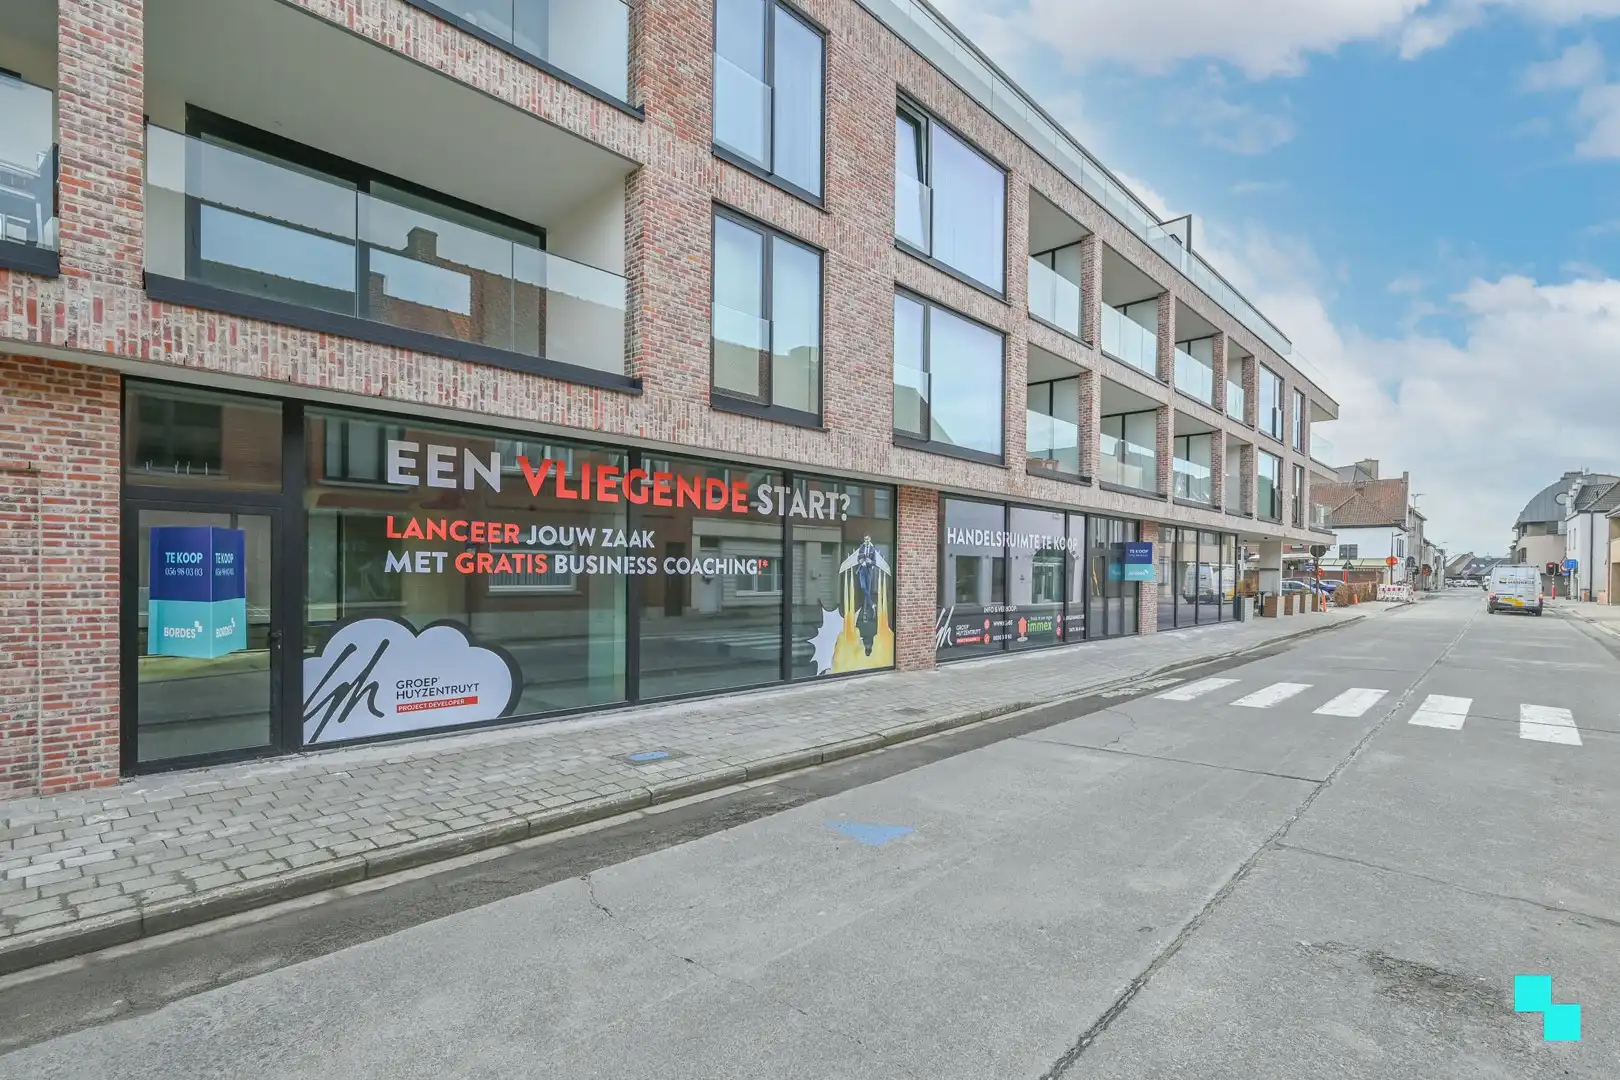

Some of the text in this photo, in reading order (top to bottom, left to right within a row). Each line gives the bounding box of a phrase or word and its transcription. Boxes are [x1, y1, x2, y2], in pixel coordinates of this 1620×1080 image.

[387, 440, 851, 521] EEN VLIEGENDE START?
[386, 516, 656, 549] LANCEER JOUW ZAAK
[947, 527, 1040, 550] HANDELSRUIMTE
[1041, 534, 1052, 550] TE
[165, 552, 203, 564] TE KOOP
[215, 553, 234, 564] TE KOOP
[384, 550, 448, 573] MET
[454, 552, 548, 574] GRATIS
[554, 554, 658, 575] BUSINESS
[164, 626, 196, 639] BORDES
[215, 625, 233, 638] BORDES
[1027, 620, 1052, 632] immex
[395, 677, 438, 690] GROEP
[396, 682, 480, 700] HUYZENTRUYT
[398, 699, 465, 712] PROJECT DEVELOPER
